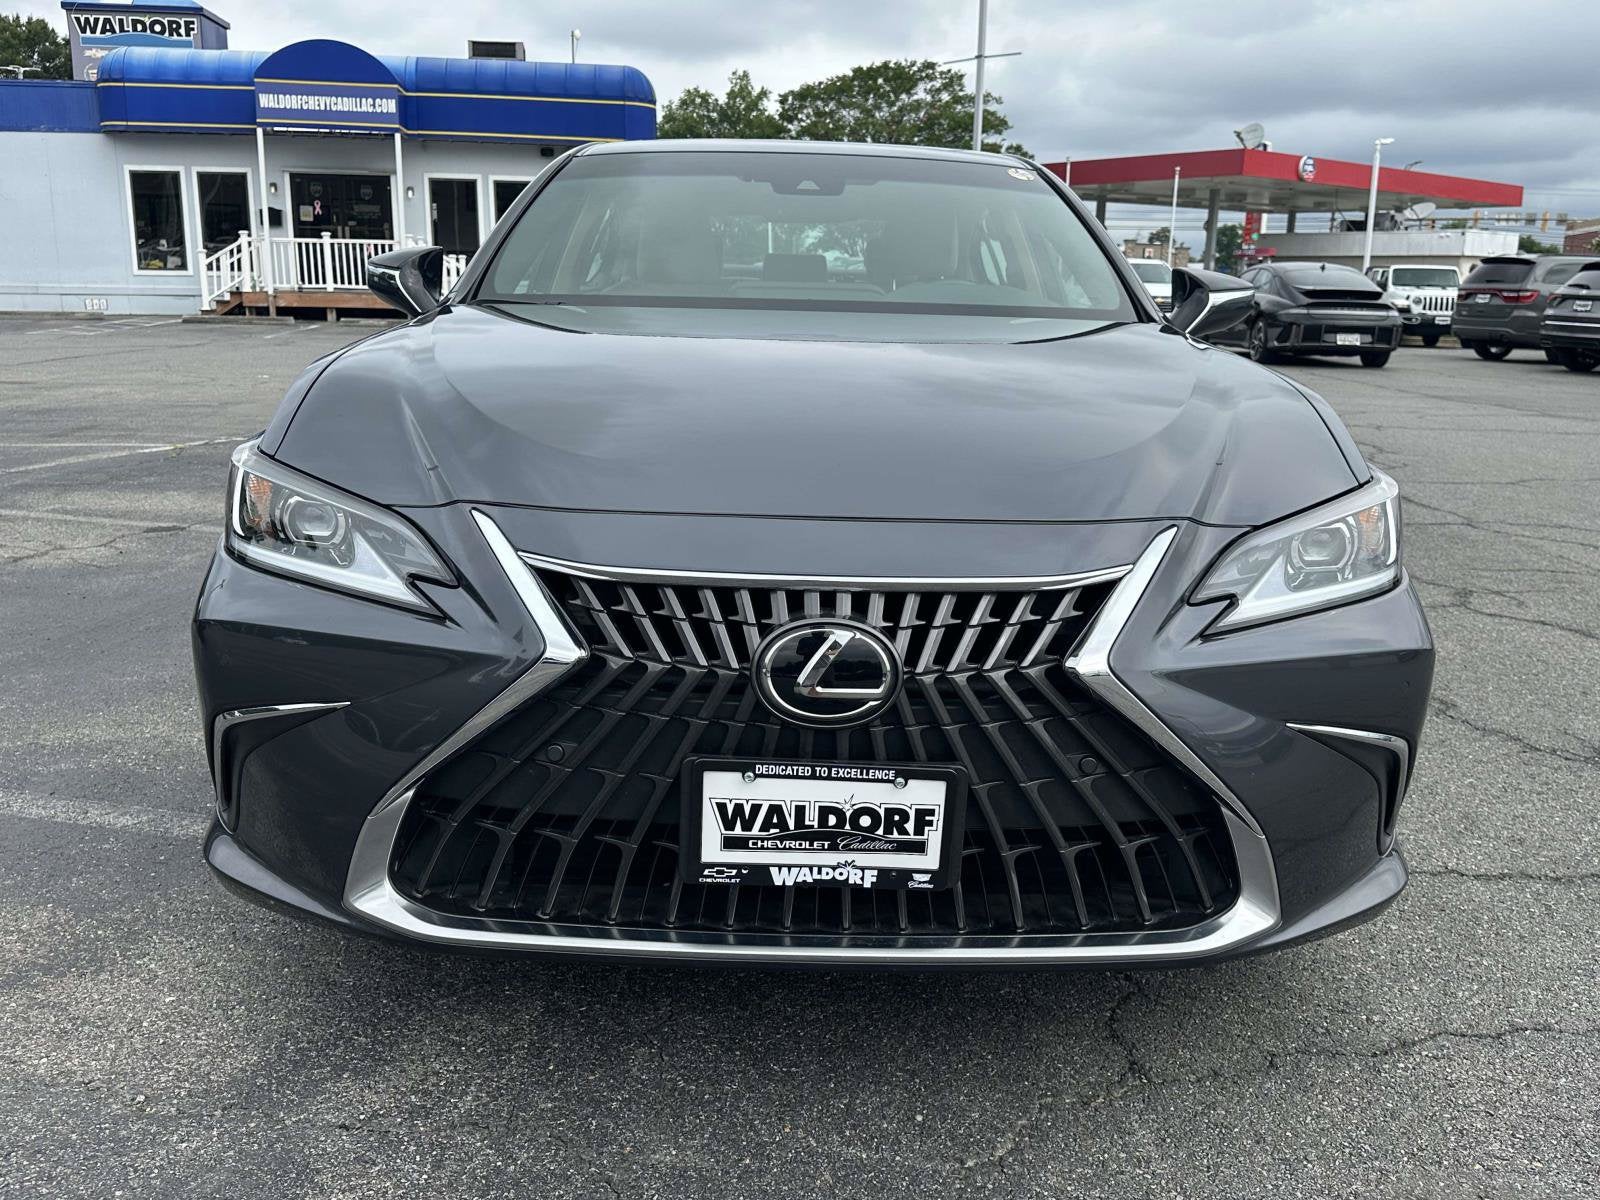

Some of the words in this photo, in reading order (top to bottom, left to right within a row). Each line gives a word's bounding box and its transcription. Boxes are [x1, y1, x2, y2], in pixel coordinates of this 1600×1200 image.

[73, 15, 197, 38] WALDORF
[258, 93, 397, 113] WALDORFCHEVYCADILLAC.COM
[755, 764, 812, 776] DEDICATED
[815, 767, 828, 777] TO
[831, 768, 896, 780] EXCELLENCE
[713, 801, 937, 837] WALDORF
[748, 839, 831, 850] CHEVROLET
[837, 836, 897, 851] Cadillac
[769, 866, 878, 888] WALDORF
